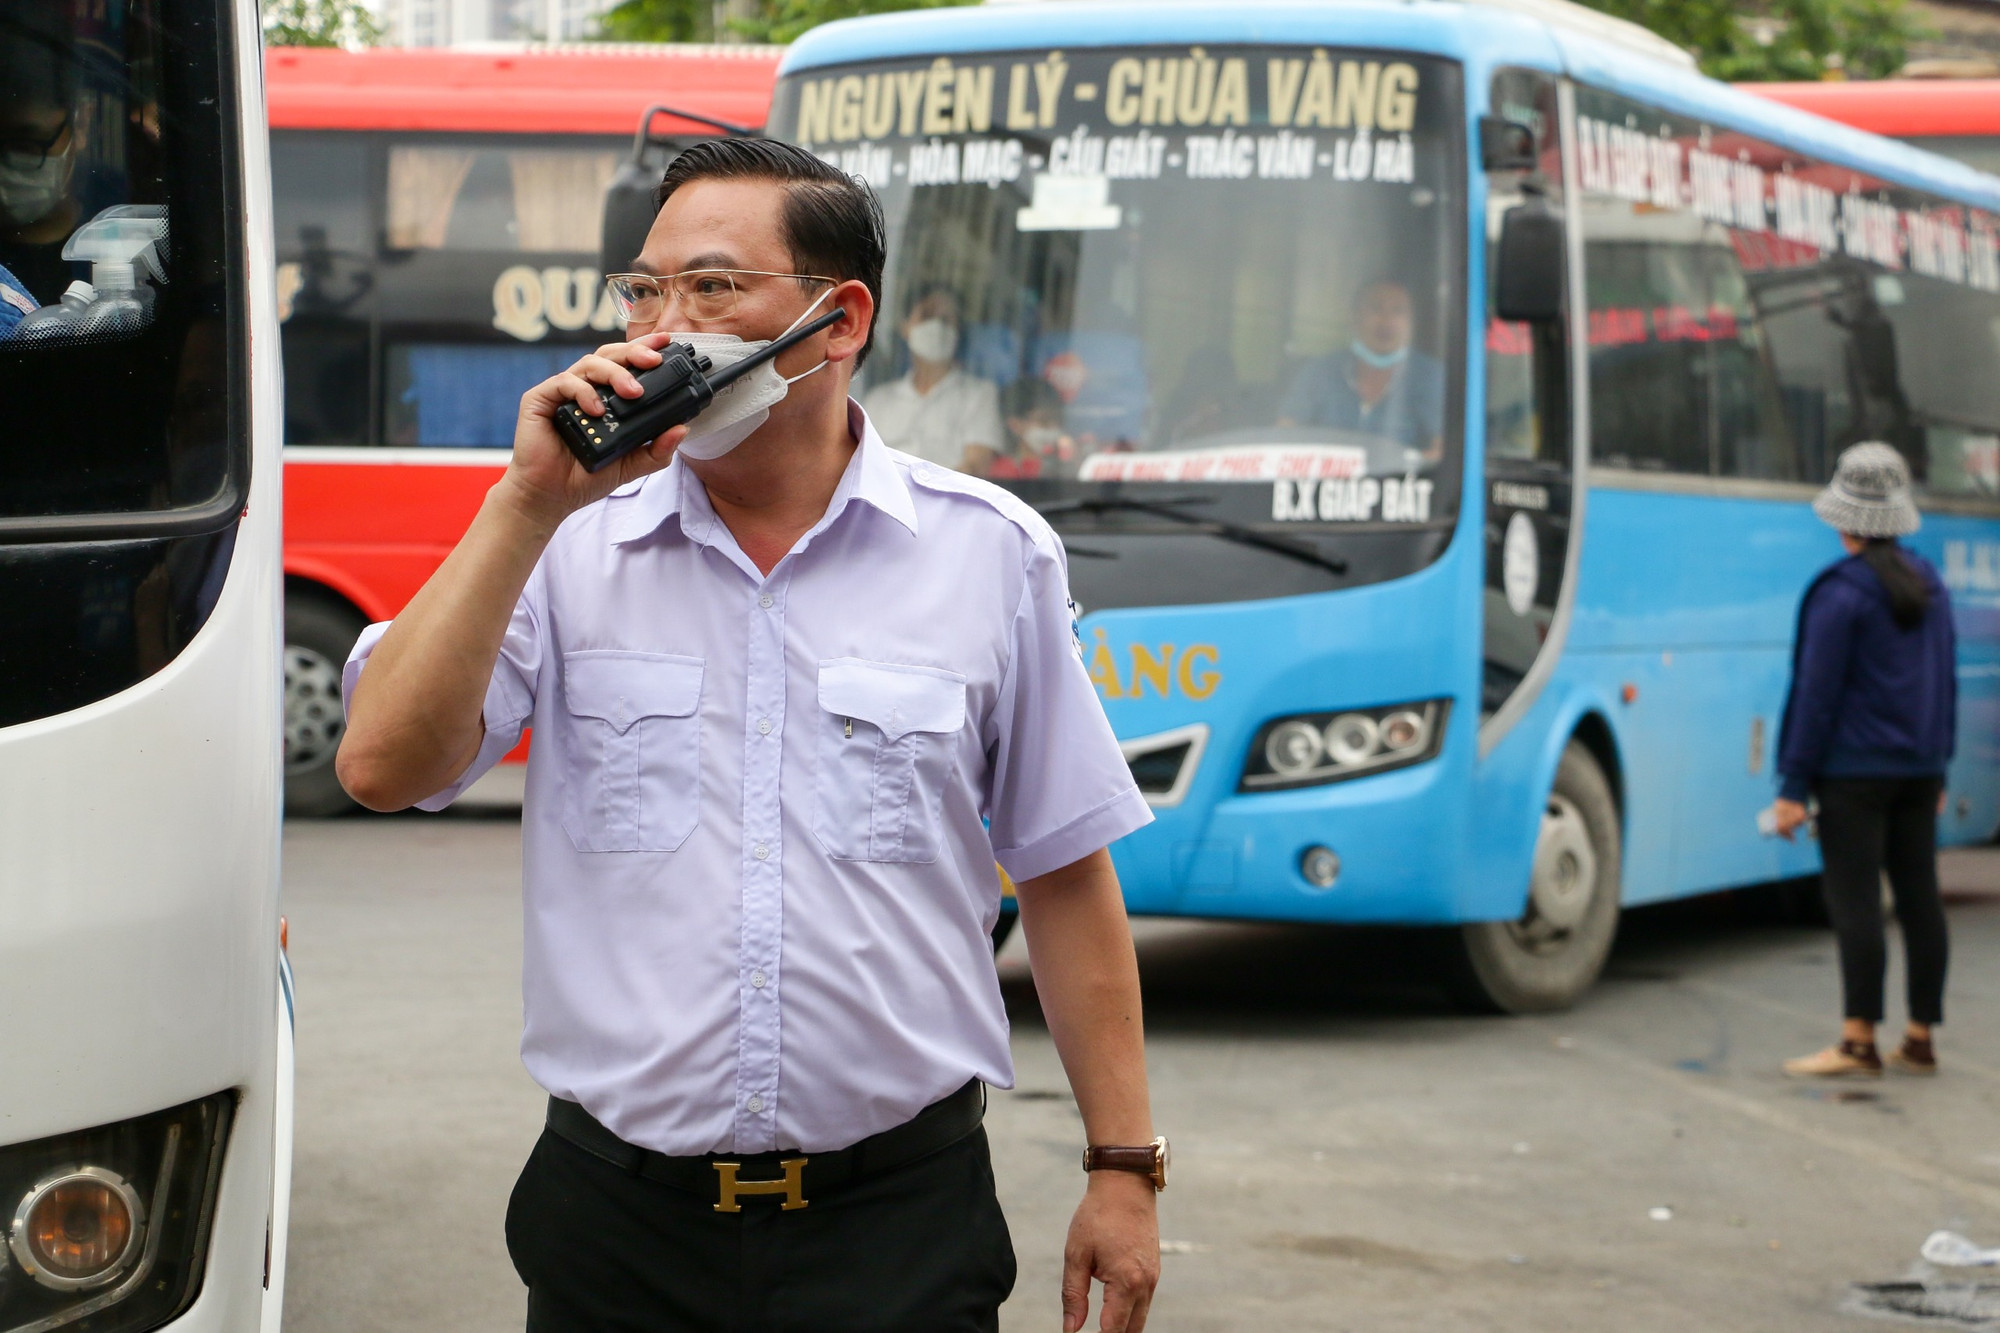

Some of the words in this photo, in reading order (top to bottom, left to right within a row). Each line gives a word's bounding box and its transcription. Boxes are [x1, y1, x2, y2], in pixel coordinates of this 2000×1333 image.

[797, 57, 995, 144] NGUYÊN
[1006, 50, 1069, 130] LÝ
[1267, 47, 1419, 131] VÀNG
[1081, 627, 1222, 701] ÀNG
[713, 1158, 809, 1213] H
